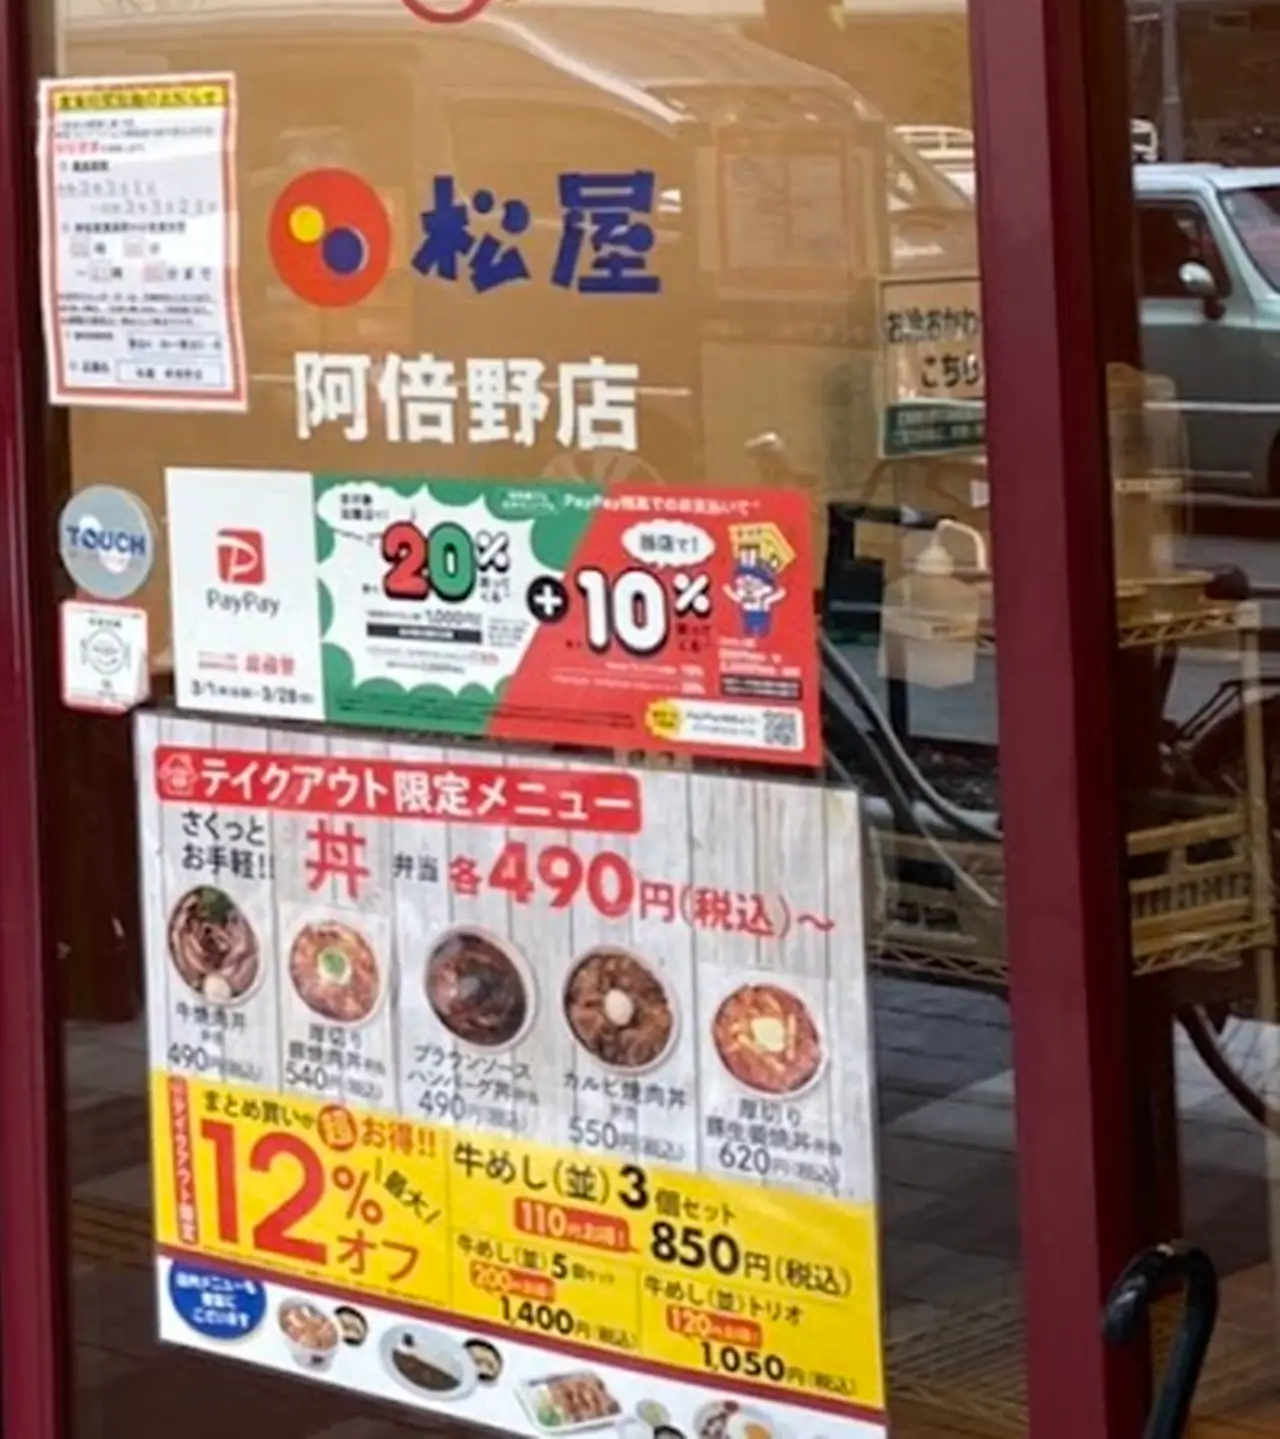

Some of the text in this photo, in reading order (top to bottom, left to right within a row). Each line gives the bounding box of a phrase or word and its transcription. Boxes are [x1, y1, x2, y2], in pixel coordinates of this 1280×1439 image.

[411, 170, 661, 294] 松屋
[294, 351, 640, 451] 阿倍野店
[66, 524, 146, 555] TOUCH
[206, 588, 281, 617] PayPay
[201, 757, 633, 821] テイクアウト限定メニュー
[181, 811, 266, 847] さくっと
[305, 817, 370, 901] 丼
[392, 852, 440, 882] 弁当
[200, 1118, 384, 1266] 12%
[336, 1229, 421, 1283] オフ
